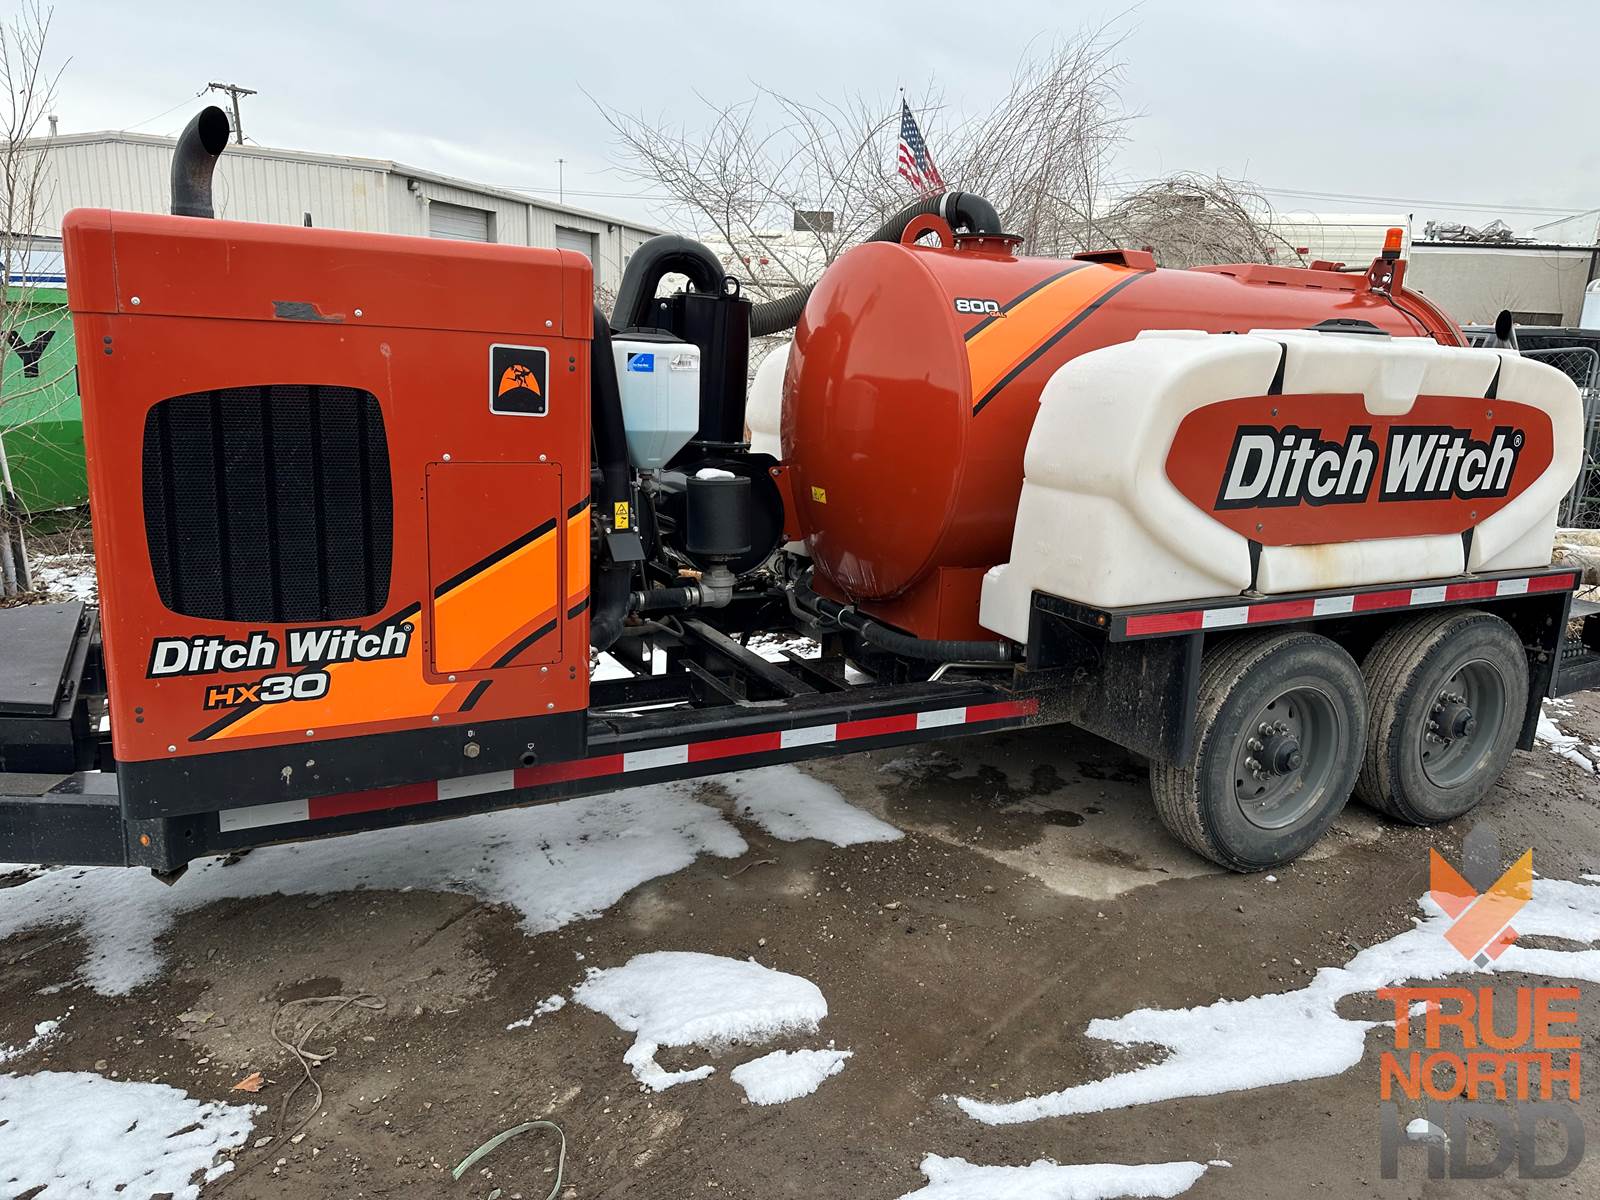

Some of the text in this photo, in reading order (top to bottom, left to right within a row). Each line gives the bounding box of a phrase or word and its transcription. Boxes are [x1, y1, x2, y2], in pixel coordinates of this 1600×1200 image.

[956, 299, 999, 313] 800
[1222, 433, 1374, 501] Ditch
[151, 633, 277, 676] Ditch
[207, 672, 328, 708] HX30
